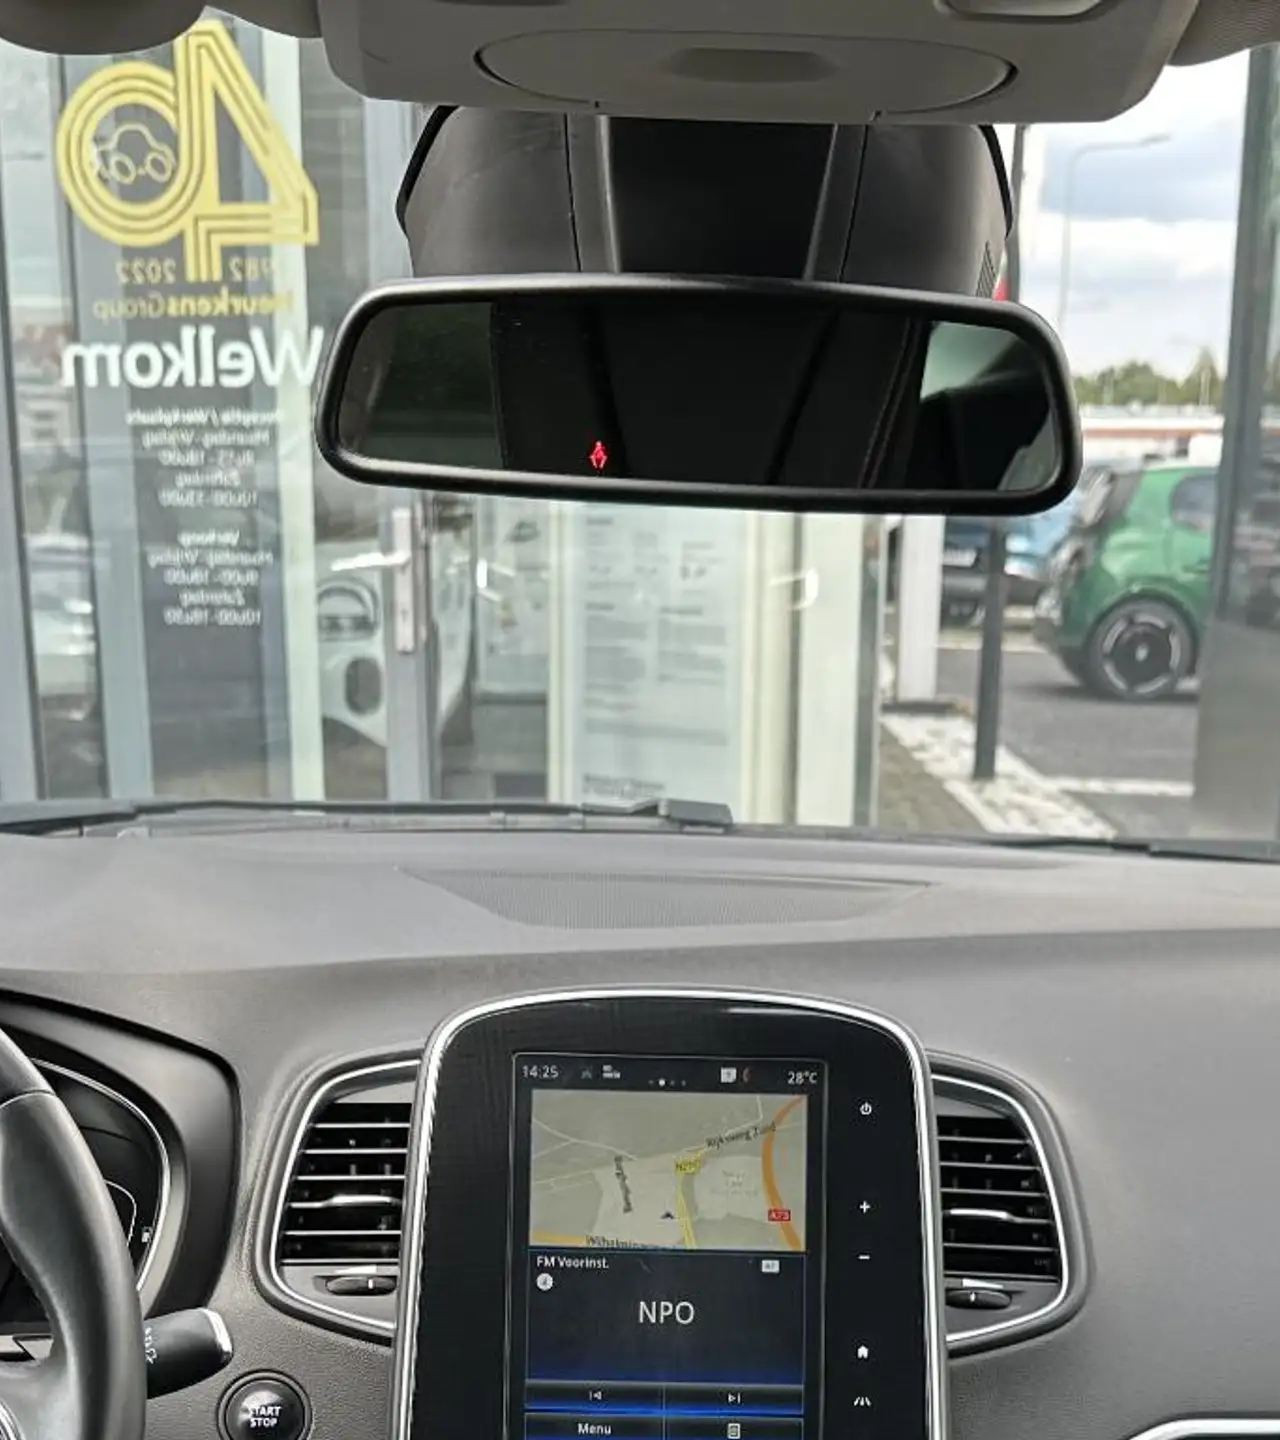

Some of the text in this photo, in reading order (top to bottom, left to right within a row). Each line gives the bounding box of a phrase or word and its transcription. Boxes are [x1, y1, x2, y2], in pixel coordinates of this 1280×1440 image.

[522, 1064, 559, 1079] 14:25
[787, 1071, 818, 1085] 28°C
[536, 1256, 609, 1269] FM Voorinst.
[638, 1301, 695, 1325] NPO
[248, 1406, 282, 1417] START
[250, 1417, 278, 1428] STOP
[577, 1422, 612, 1435] Menu
